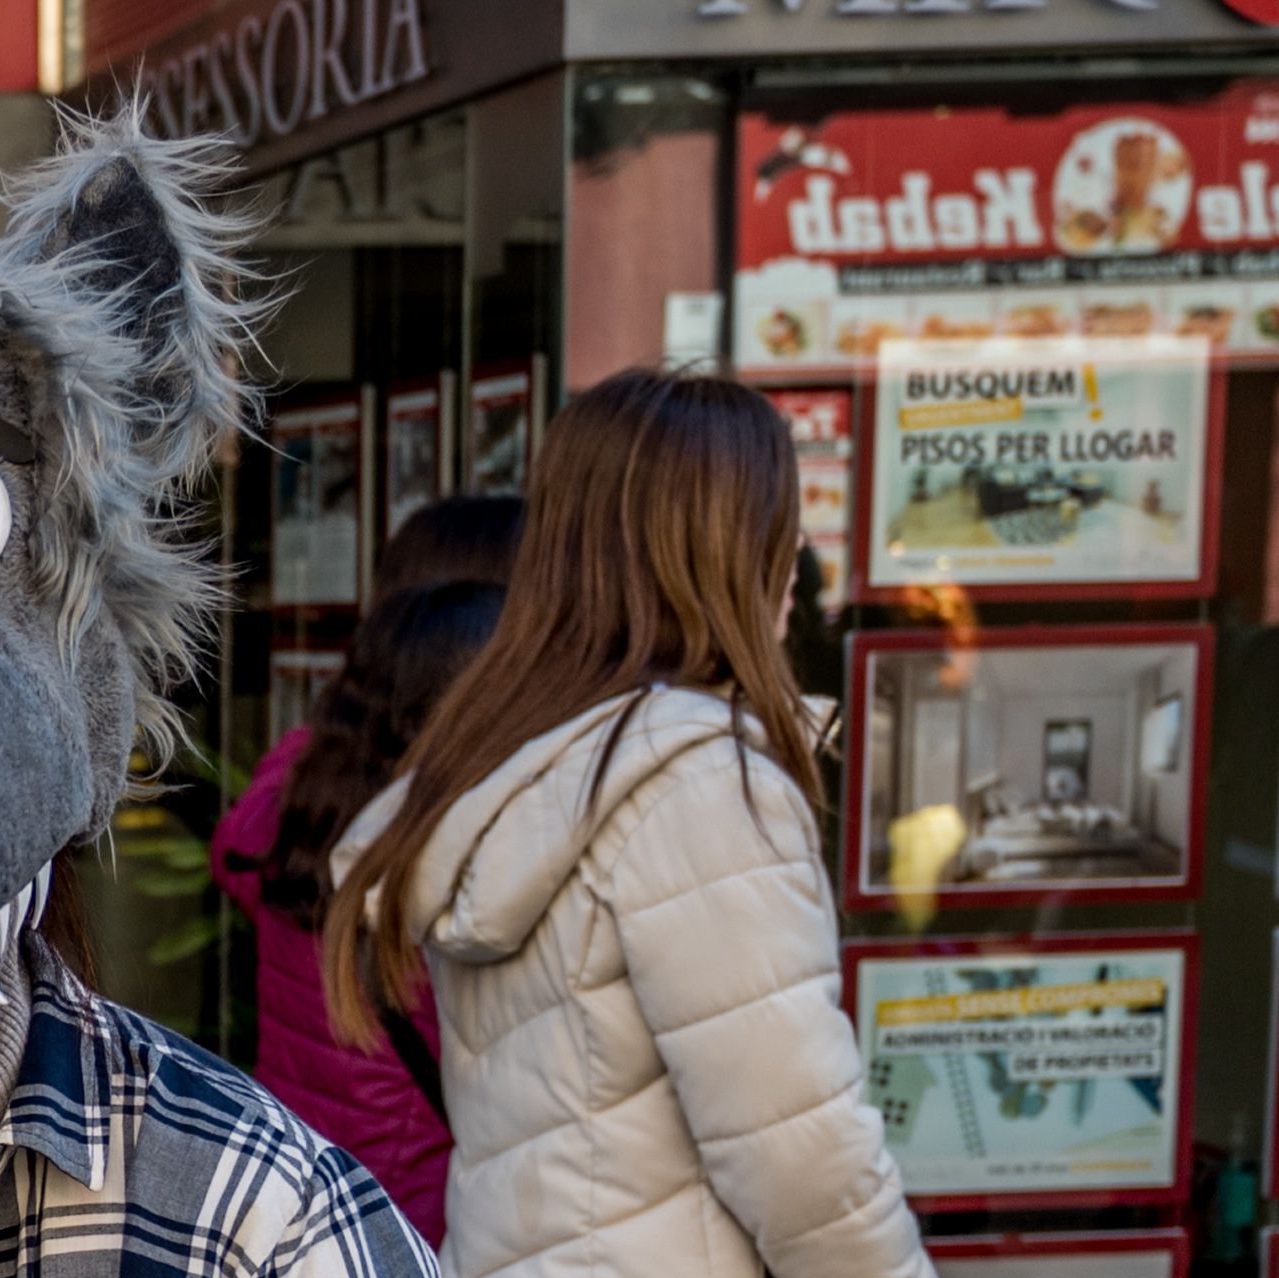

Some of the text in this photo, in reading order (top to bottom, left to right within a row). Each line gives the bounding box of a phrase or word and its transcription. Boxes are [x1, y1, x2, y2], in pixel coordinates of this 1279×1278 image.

[905, 368, 1076, 402] BUSQUEM
[900, 429, 1177, 465] PISOS PER LLOGAR
